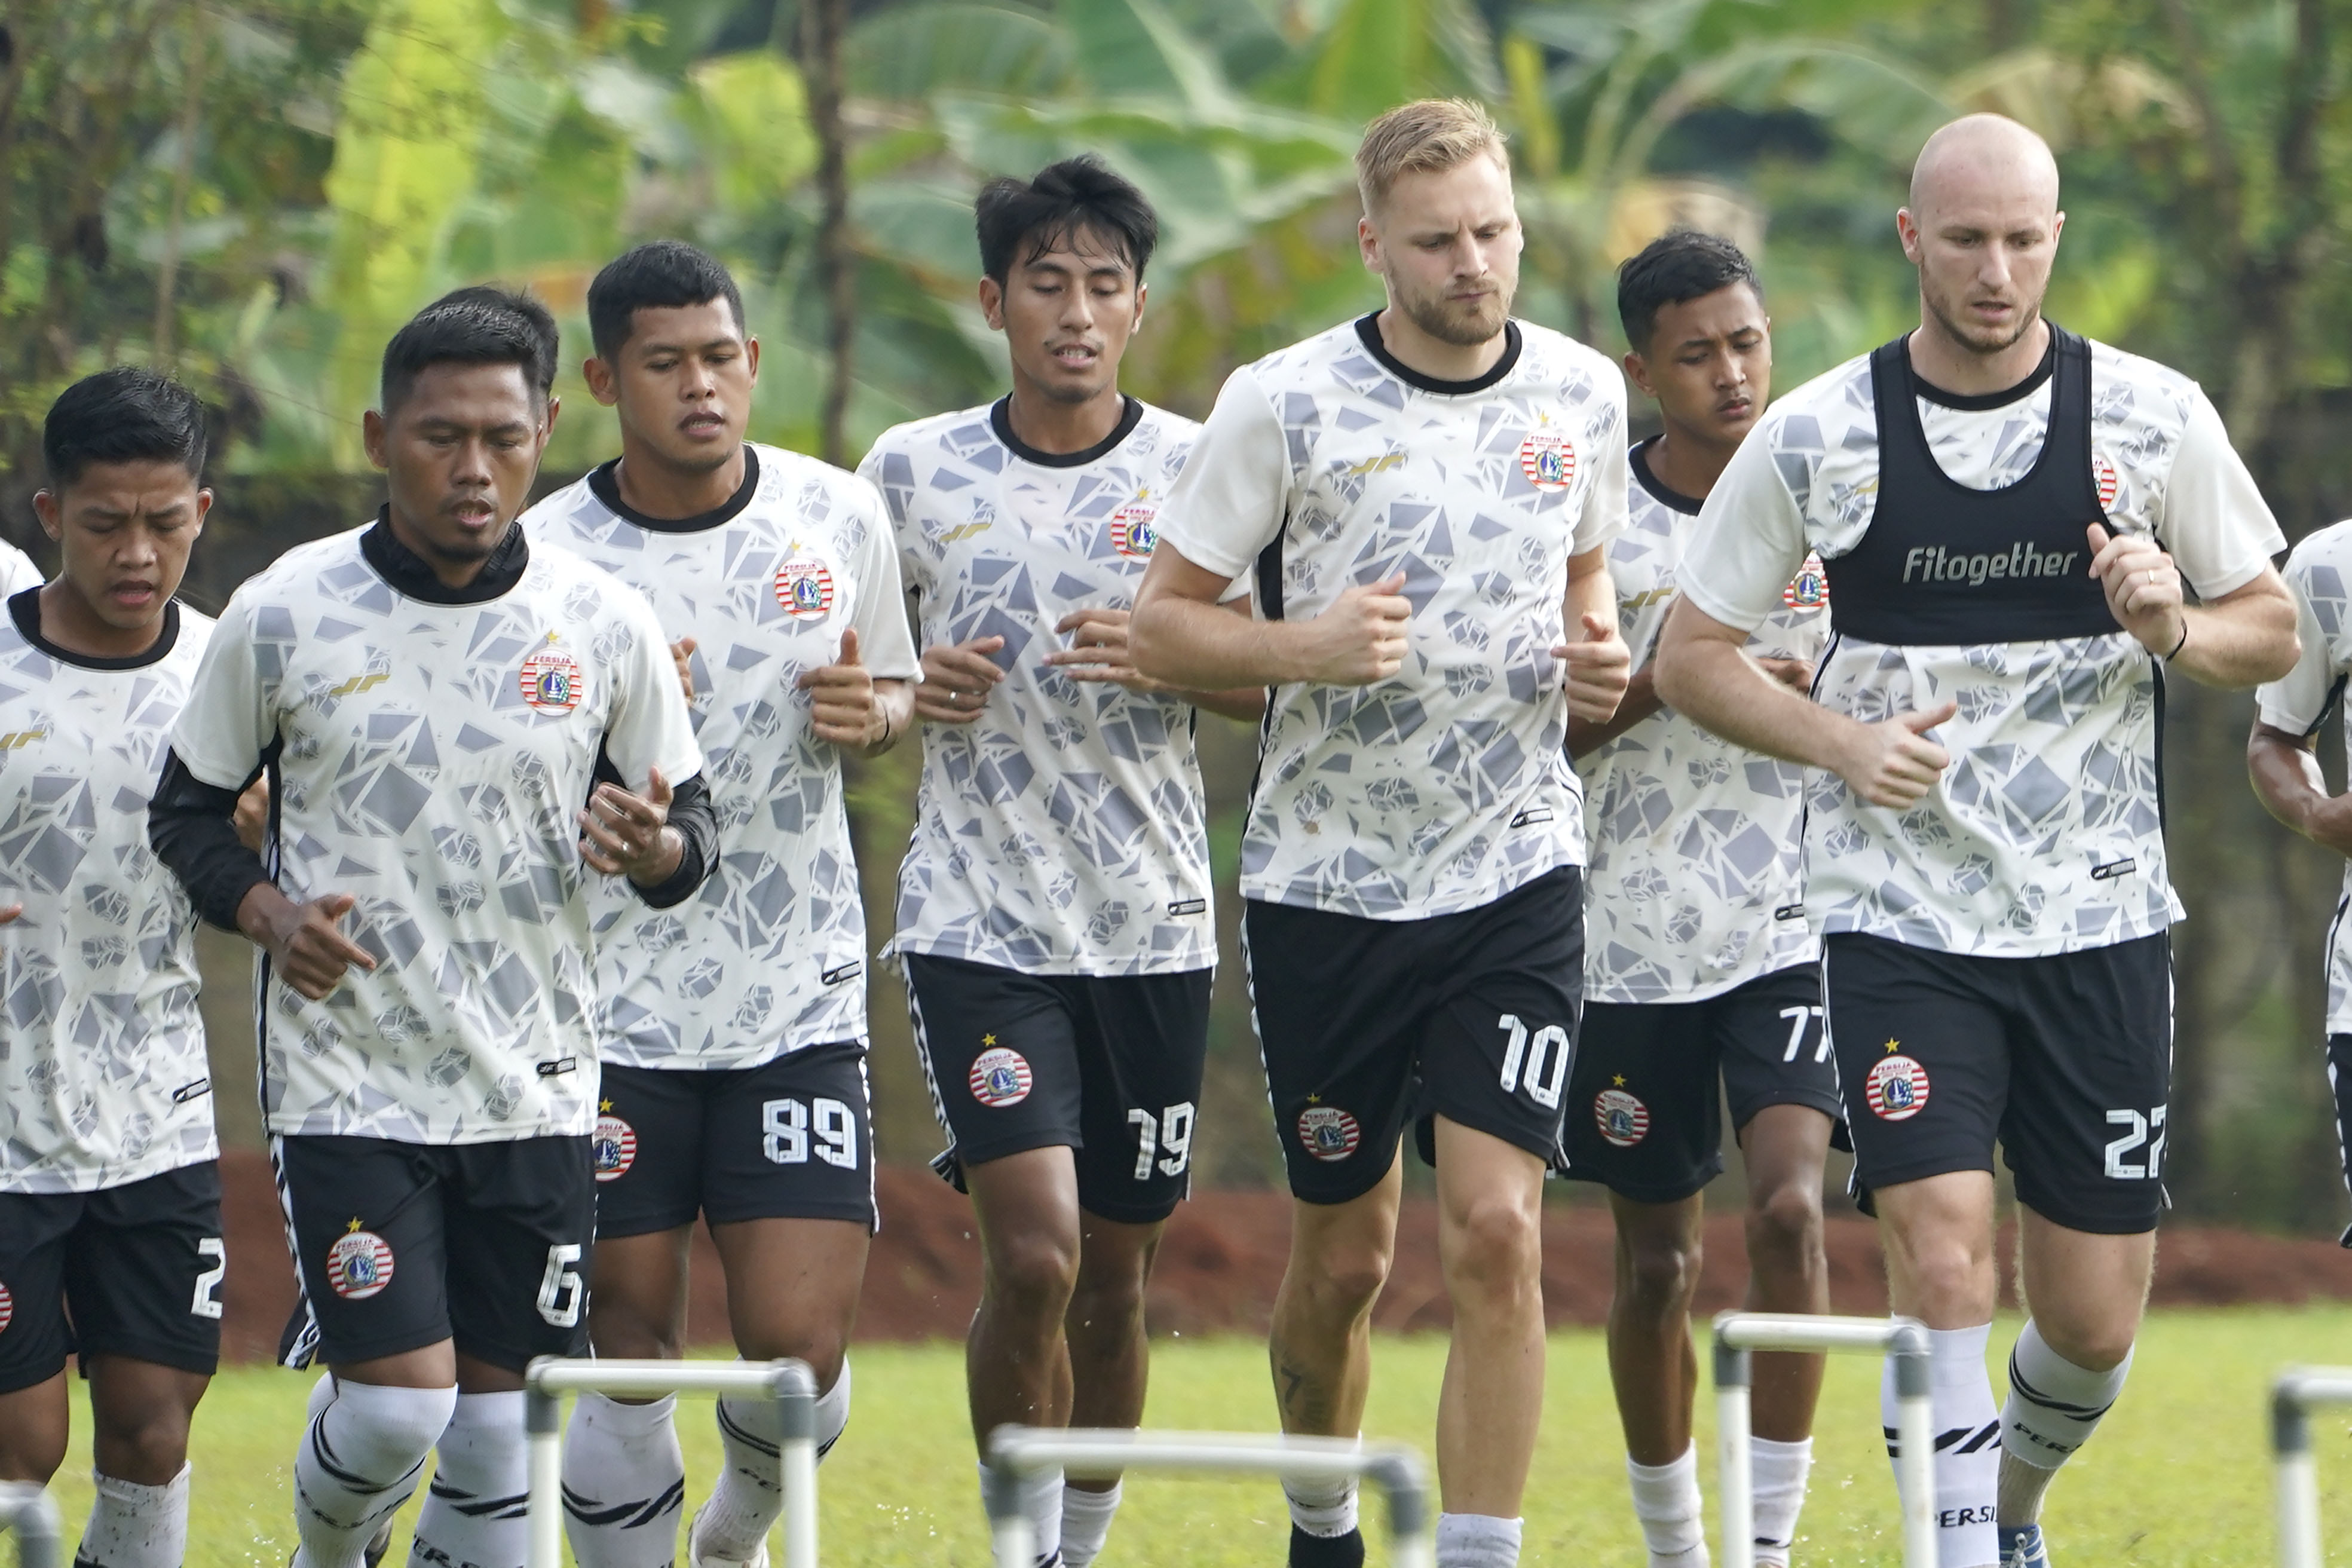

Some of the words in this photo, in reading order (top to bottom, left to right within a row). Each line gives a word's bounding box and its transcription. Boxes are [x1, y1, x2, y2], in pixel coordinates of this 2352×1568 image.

[1903, 541, 2078, 586] Fitogether
[533, 656, 571, 664] PERSIJA
[1498, 1013, 1569, 1110] 10
[1876, 1061, 1912, 1073] PERSIJA
[762, 1098, 857, 1171] 89
[1128, 1101, 1195, 1180] 19
[191, 1238, 226, 1319] 2
[536, 1244, 583, 1328] 6
[1934, 1506, 1998, 1527] ERSI
